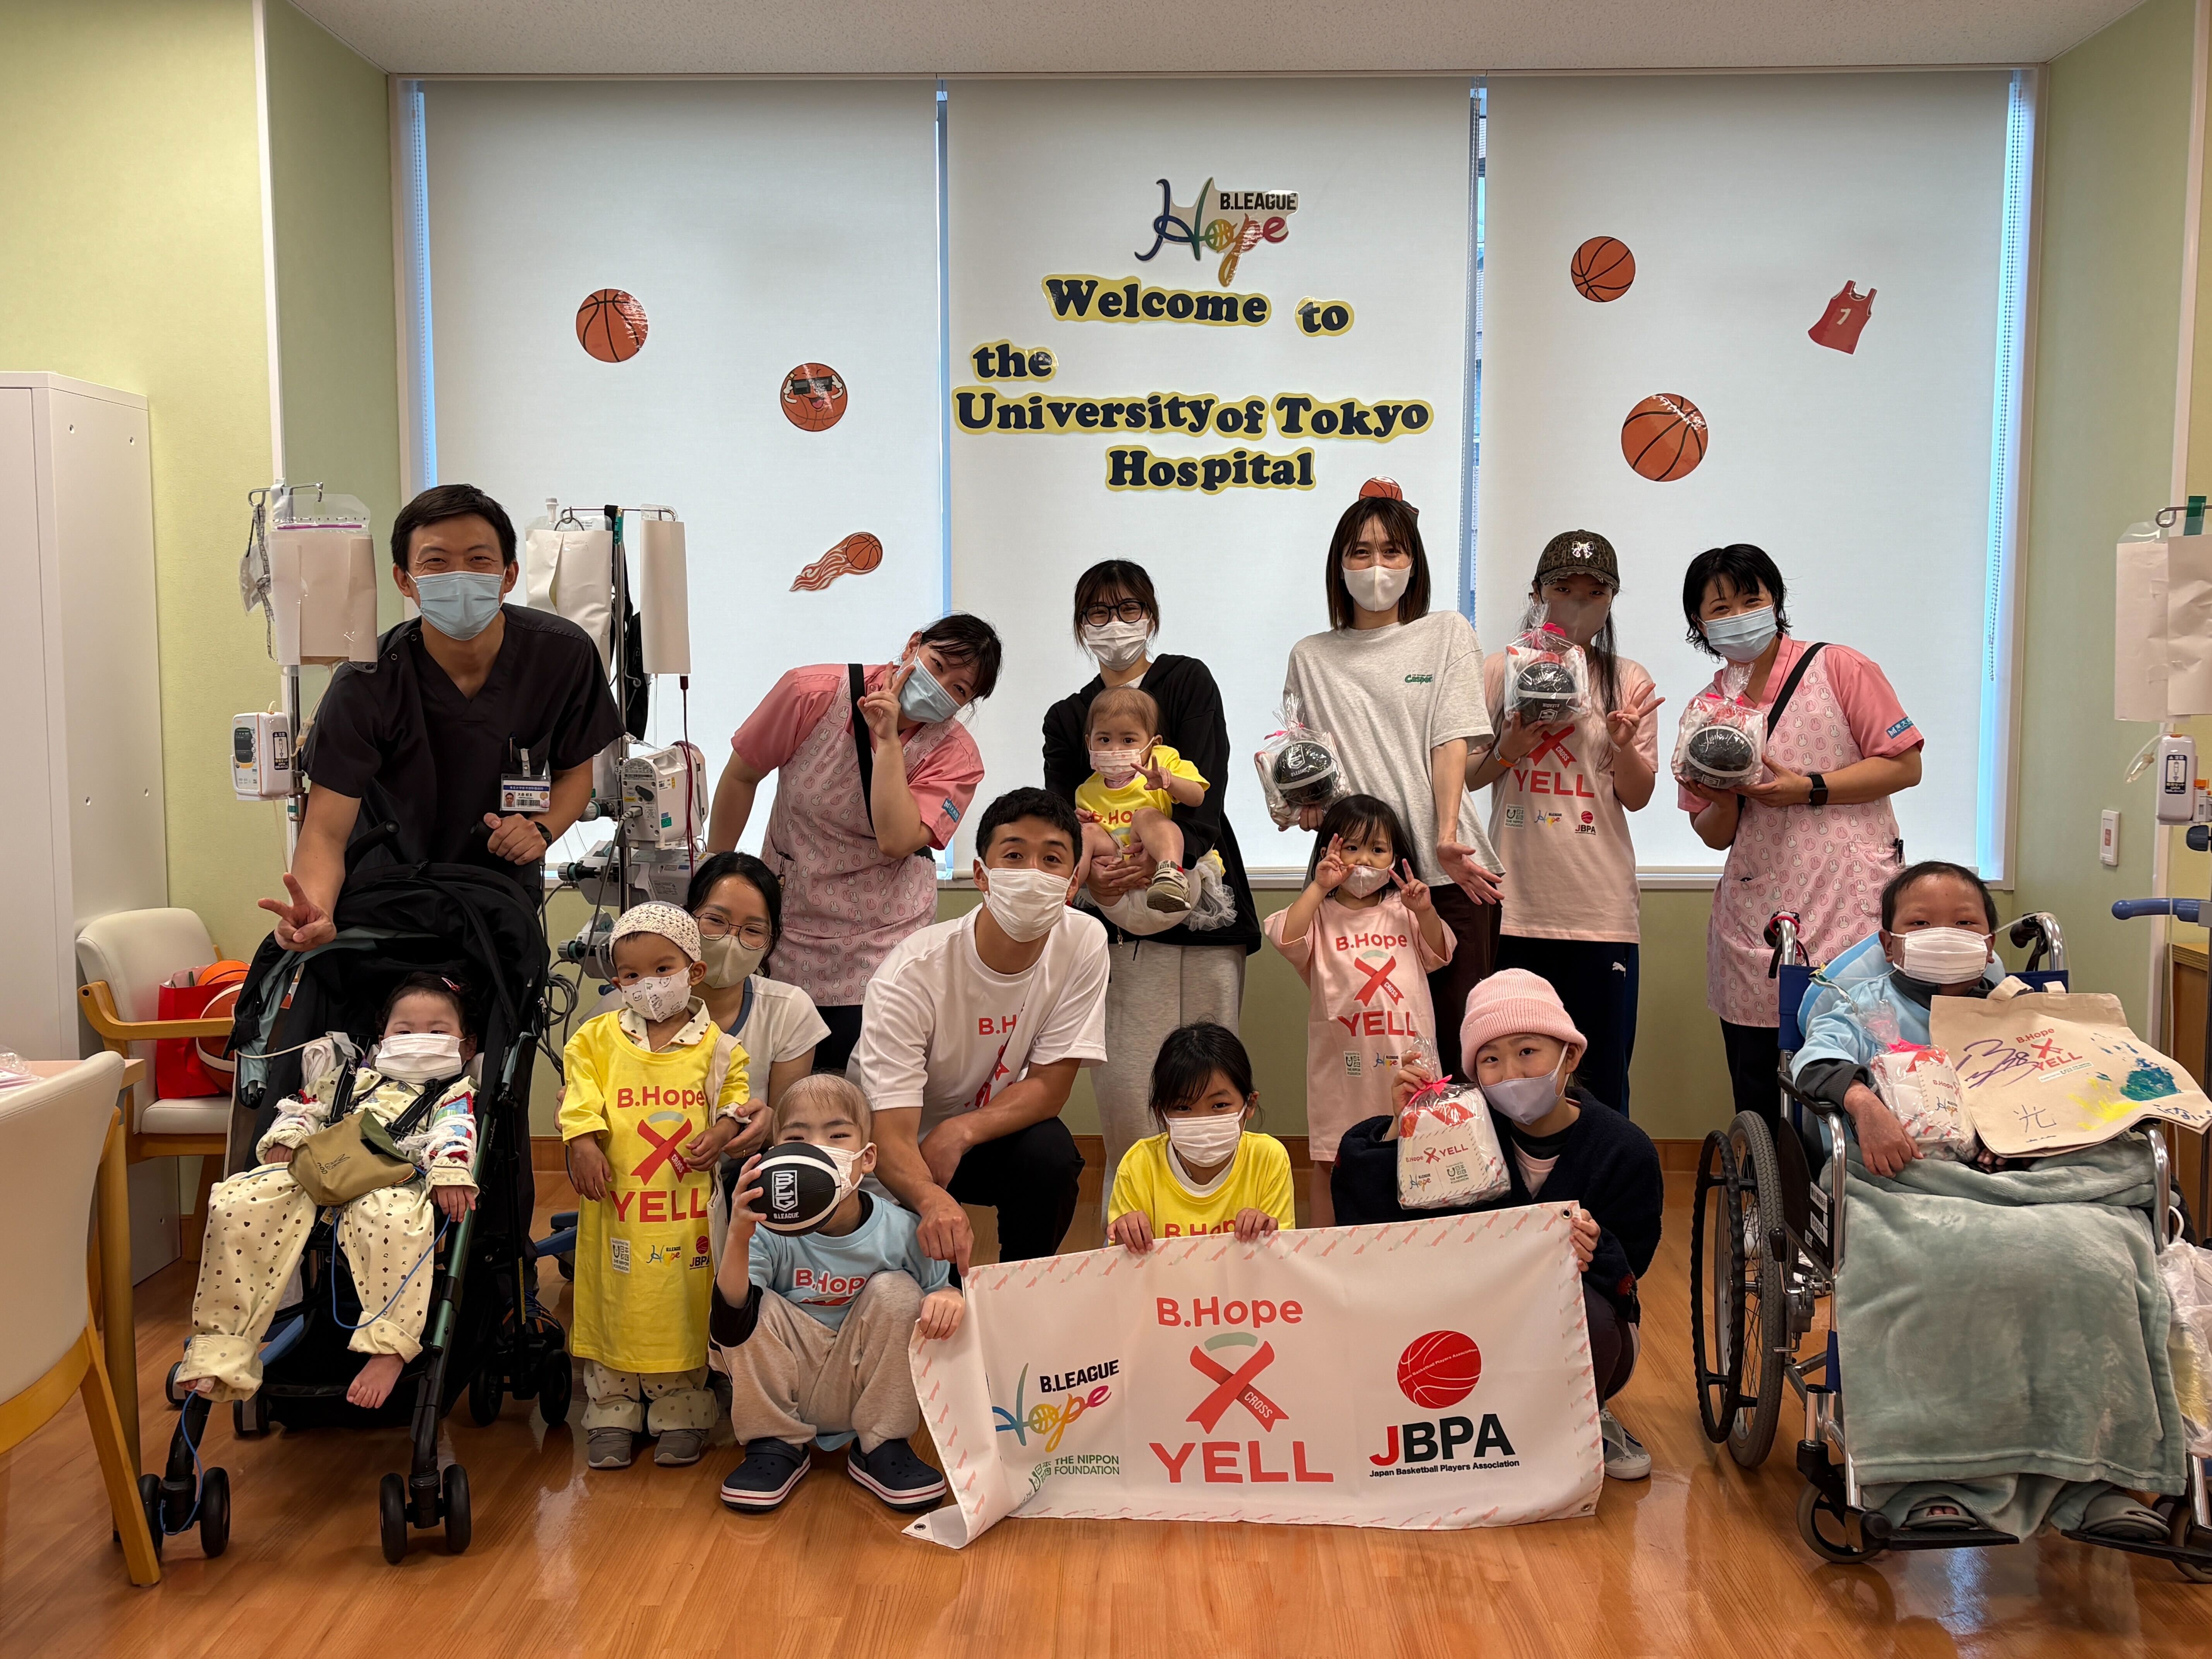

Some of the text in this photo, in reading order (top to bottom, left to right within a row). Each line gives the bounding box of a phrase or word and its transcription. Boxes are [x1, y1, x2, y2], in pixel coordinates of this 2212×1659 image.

[1220, 192, 1297, 211] B.LEAGUE
[1135, 177, 1288, 287] Hope
[1046, 278, 1349, 333] Welcome to
[972, 344, 1053, 378] the
[956, 392, 1429, 438] University of Tokyo
[1108, 449, 1315, 491] Hospital
[1556, 746, 1570, 761] CROSS
[1513, 769, 1595, 798] YELL
[1091, 809, 1135, 825] B.Ho
[1575, 825, 1596, 833] JBPA
[1336, 933, 1408, 951] B.Hope
[1384, 982, 1398, 998] CROSS
[979, 1014, 1017, 1035] B.H
[1337, 1010, 1417, 1037] YELL
[2016, 1028, 2055, 1043] B.Hope
[2033, 1052, 2083, 1071] YELL
[617, 1085, 705, 1109] B.Hope
[1439, 1144, 1469, 1157] YELL
[672, 1154, 685, 1173] CROSS
[1409, 1174, 1432, 1192] Hope
[610, 1188, 708, 1223] YELL
[1165, 1219, 1236, 1238] BHop
[796, 1269, 865, 1295] B.Hop
[1156, 1296, 1303, 1328] B.Hope
[1039, 1359, 1120, 1393] B.LEAGUE
[1244, 1391, 1273, 1419] CROSS
[1369, 1413, 1516, 1466] JBPA
[1054, 1466, 1120, 1475] FOUNDATION
[1055, 1455, 1119, 1465] THE NIPPON
[1149, 1440, 1334, 1484] YELL
[1396, 1465, 1438, 1475] Basketball
[1440, 1463, 1471, 1473] Players
[1473, 1460, 1520, 1470] Association
